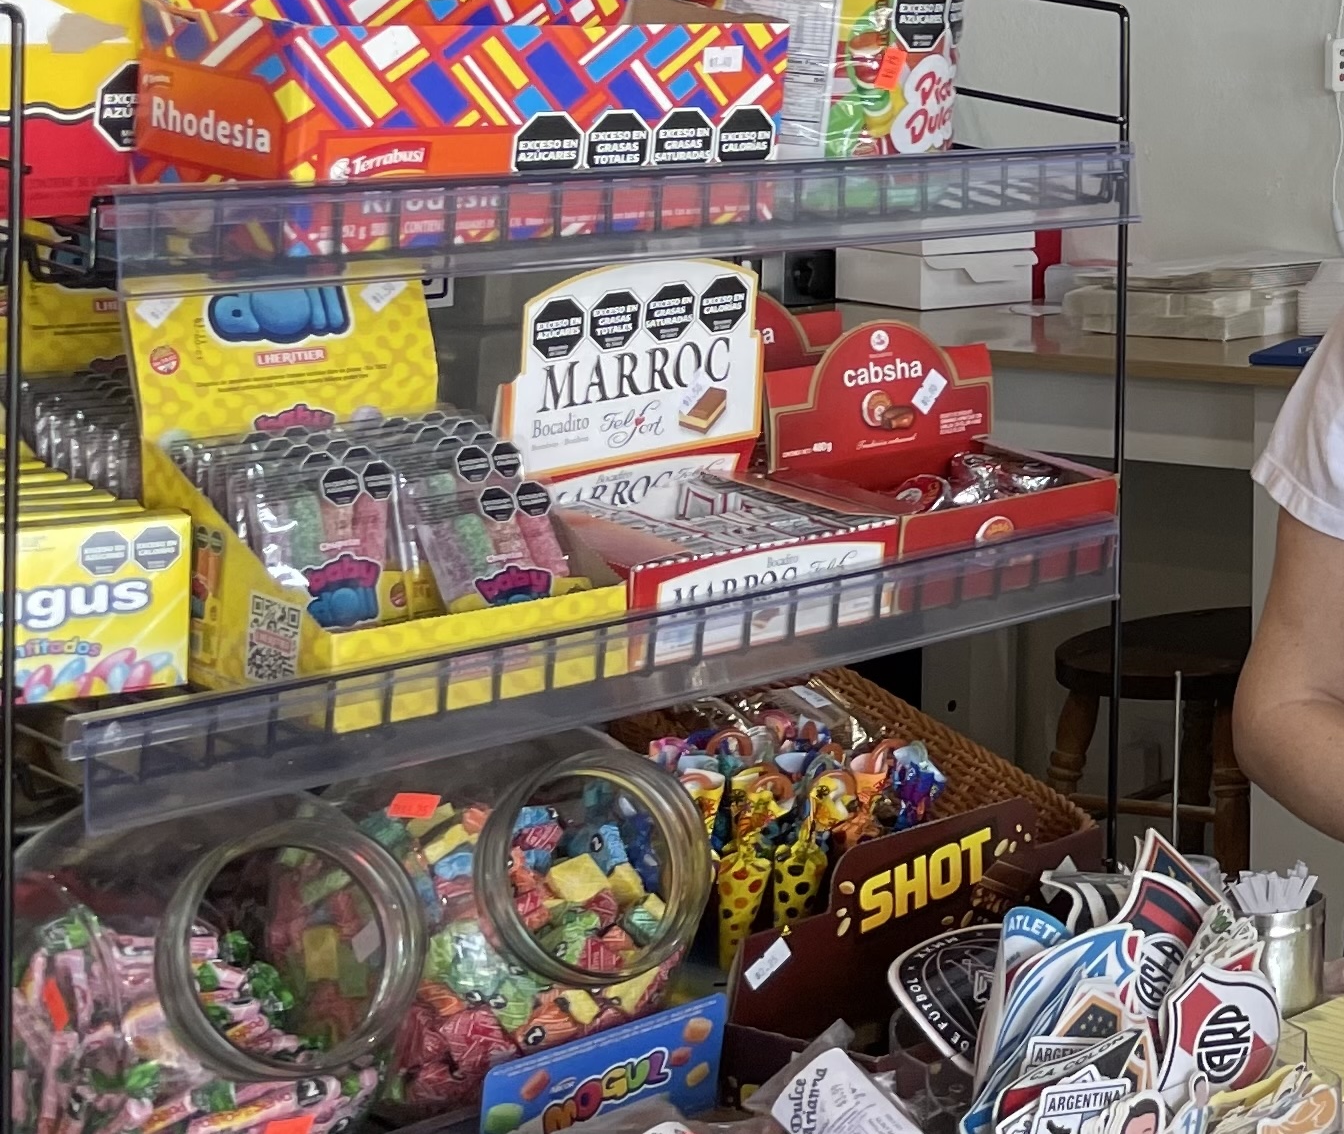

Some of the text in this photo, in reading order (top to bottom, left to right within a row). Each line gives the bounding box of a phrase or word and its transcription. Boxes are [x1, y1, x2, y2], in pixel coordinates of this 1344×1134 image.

[152, 95, 272, 154] Rhodesia
[590, 130, 647, 142] EXCESO EN
[659, 126, 710, 138] EXCESO EN
[721, 130, 771, 142] EXCESO EN
[518, 139, 578, 151] EXCESO EN
[596, 142, 640, 153] GRASAS
[664, 139, 703, 151] GRASAS
[353, 147, 426, 174] Terrabusi
[517, 149, 577, 163] AZÚCARES
[593, 153, 640, 165] TOTALES
[654, 150, 712, 163] SATURADAS
[654, 306, 686, 318] GRASAS
[598, 314, 632, 326] GRASAS
[595, 323, 633, 336] TOTALES
[257, 348, 325, 366] LHERITIER
[536, 336, 732, 414] MARROC
[843, 358, 923, 388] cabsha
[531, 412, 590, 439] Bocadito
[860, 826, 992, 934] SHOT
[1034, 1046, 1084, 1063] ARGEN
[543, 1048, 670, 1134] MOGUL
[788, 1078, 807, 1134] Dulce
[1047, 1089, 1122, 1114] ARGENTINA
